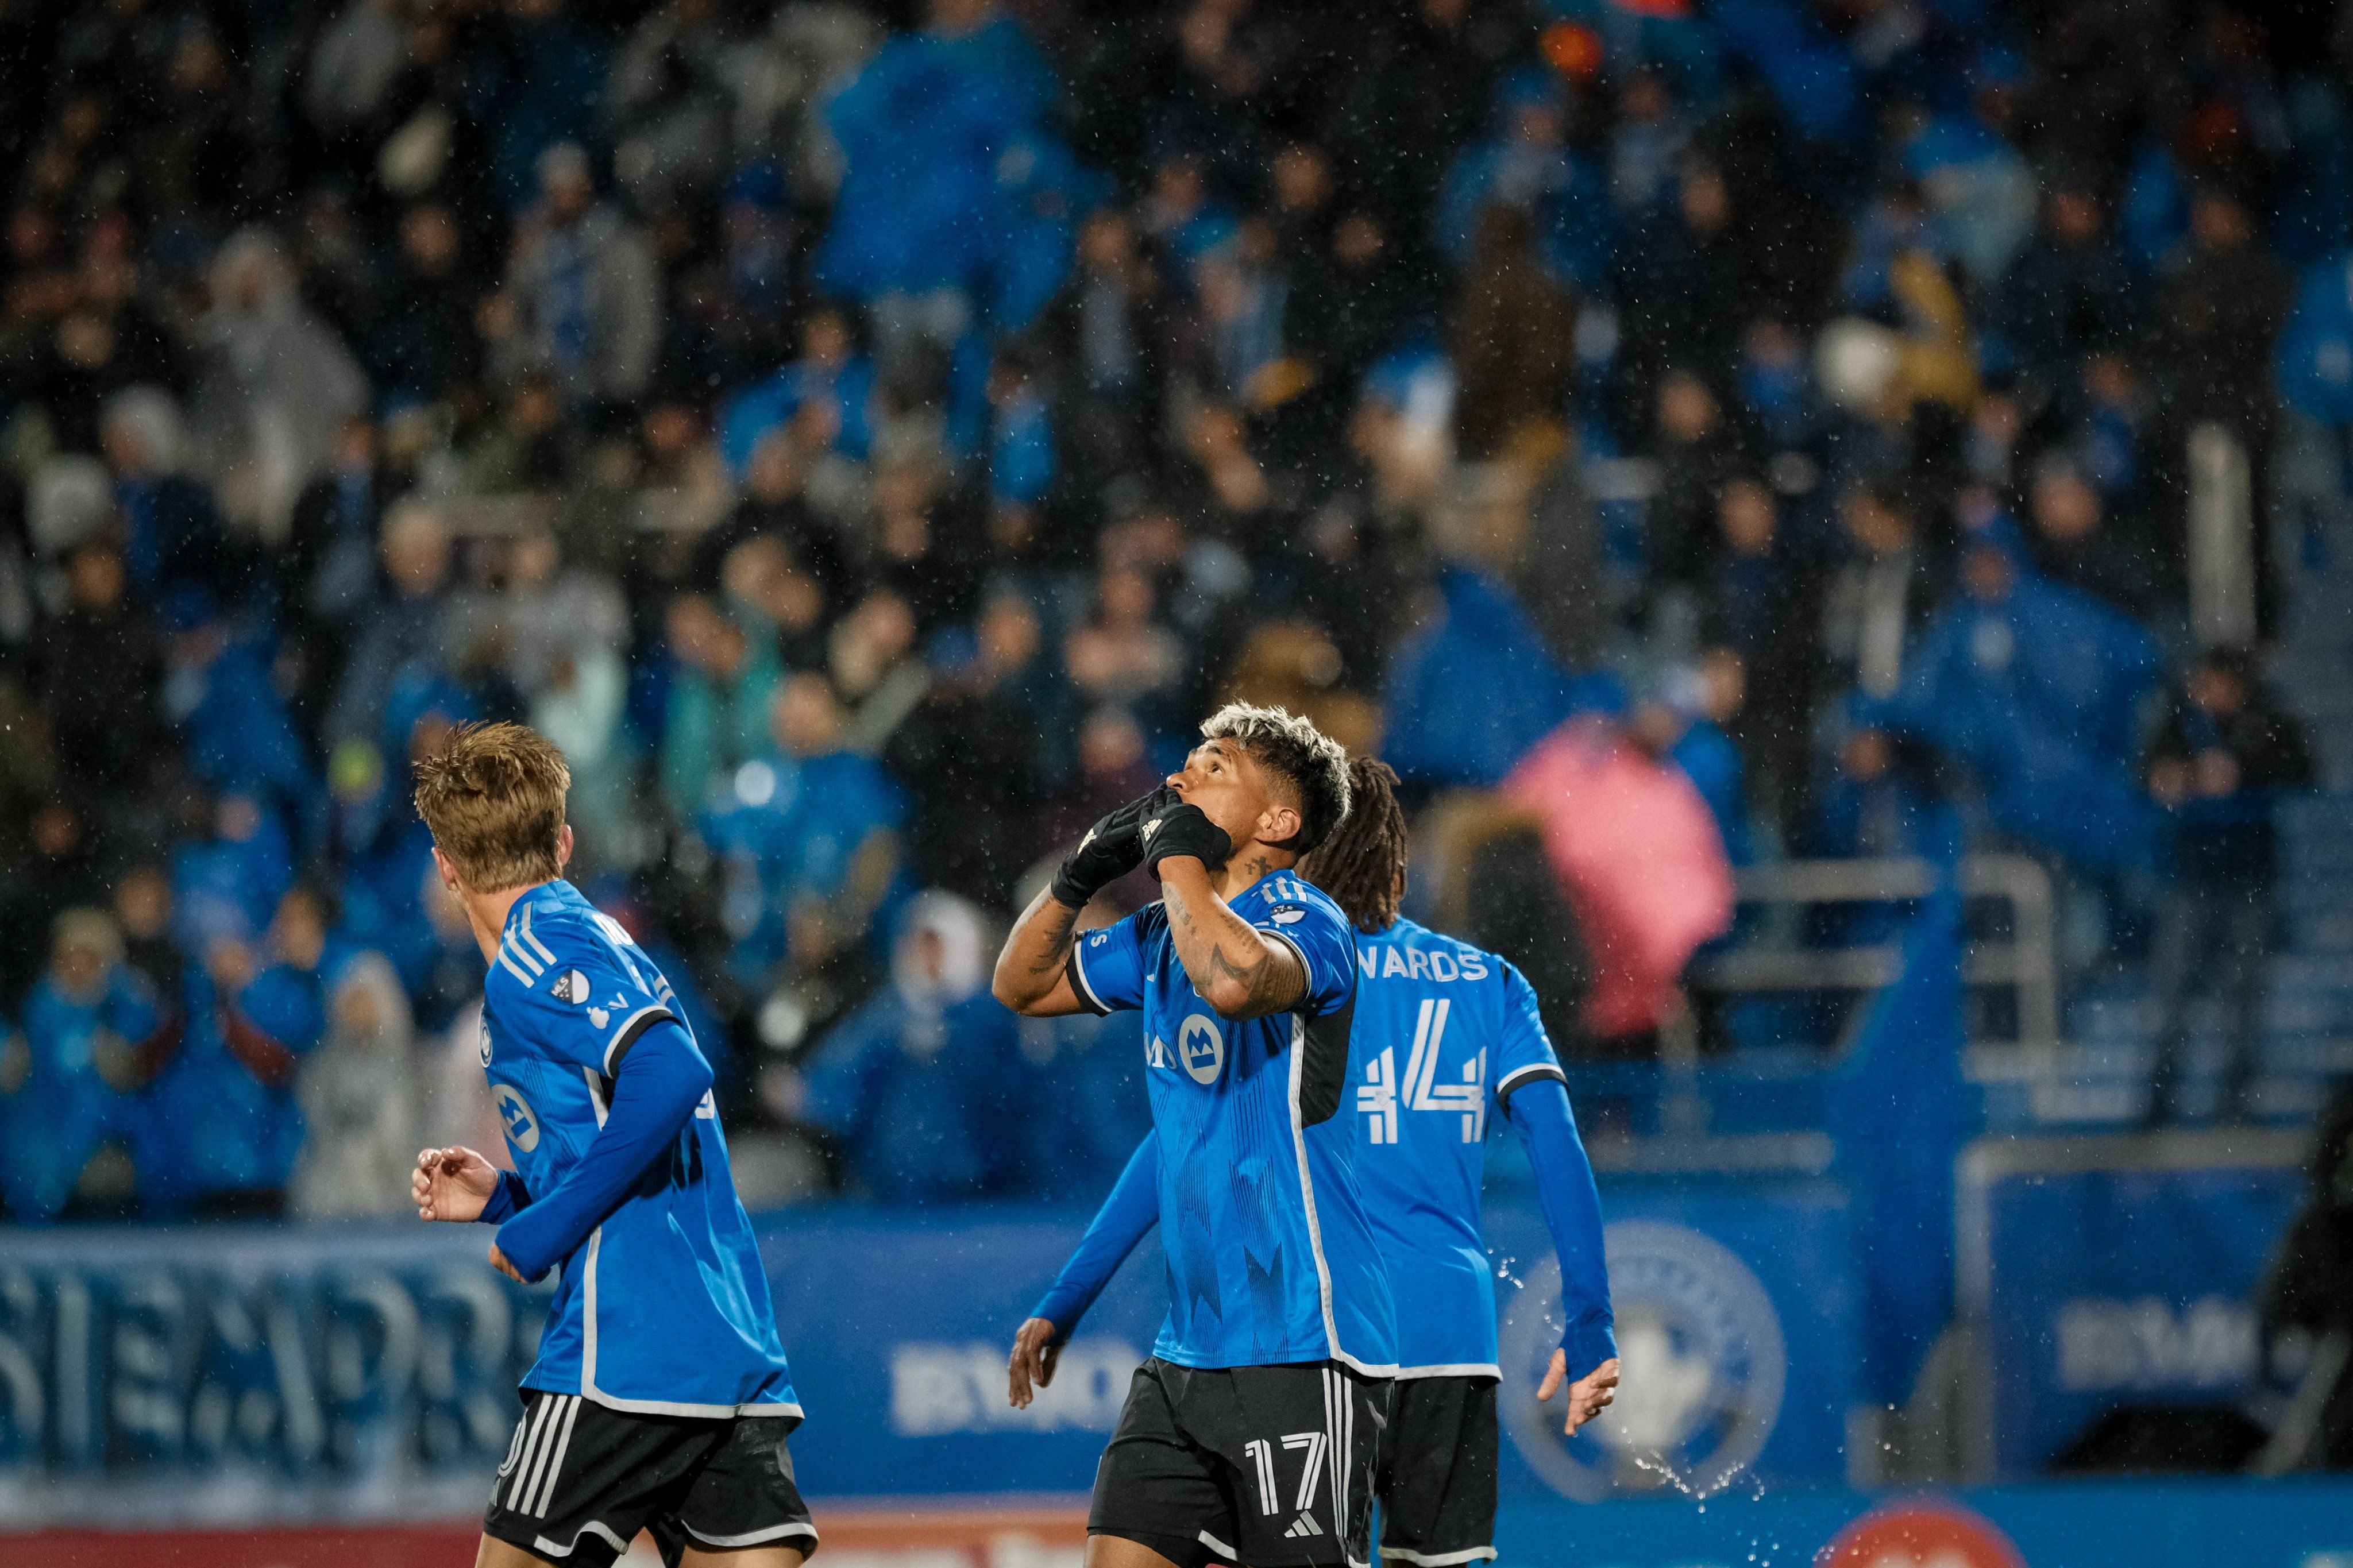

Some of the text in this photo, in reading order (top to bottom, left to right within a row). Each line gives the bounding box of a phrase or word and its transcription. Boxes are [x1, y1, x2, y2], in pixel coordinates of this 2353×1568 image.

[551, 977, 569, 997] MLS
[0, 1266, 542, 1462] SIEMPR
[1245, 1432, 1328, 1516] 17
